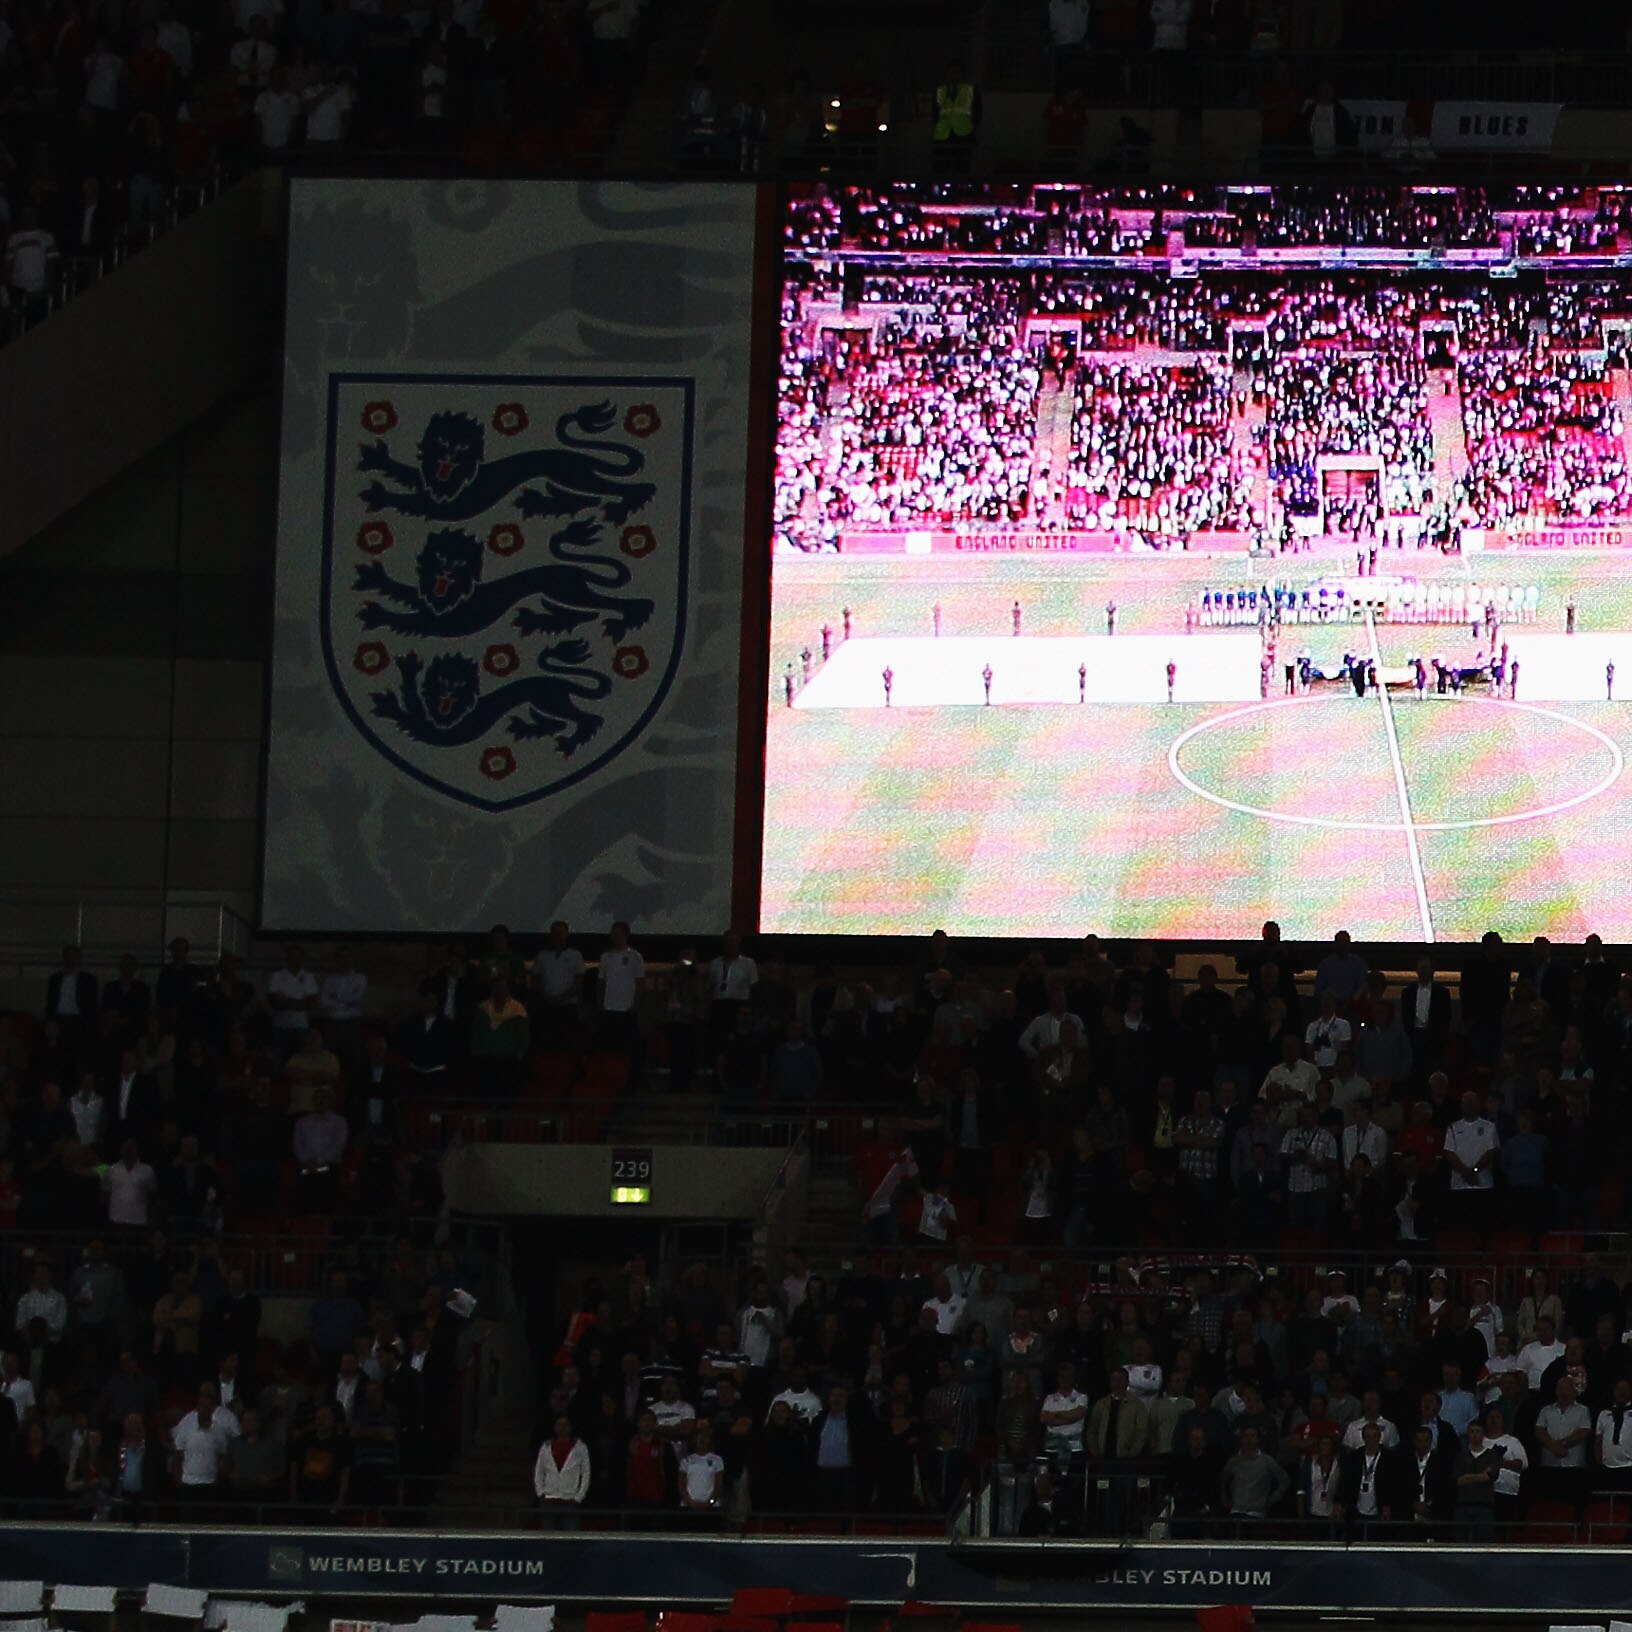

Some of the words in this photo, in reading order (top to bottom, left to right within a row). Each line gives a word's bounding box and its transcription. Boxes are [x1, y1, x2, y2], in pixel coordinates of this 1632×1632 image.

[1458, 114, 1530, 137] BLUES
[613, 1160, 651, 1180] 239
[308, 1557, 426, 1576] WEMBLEY
[435, 1558, 545, 1577] STADIUM
[1161, 1569, 1273, 1588] STADIUM
